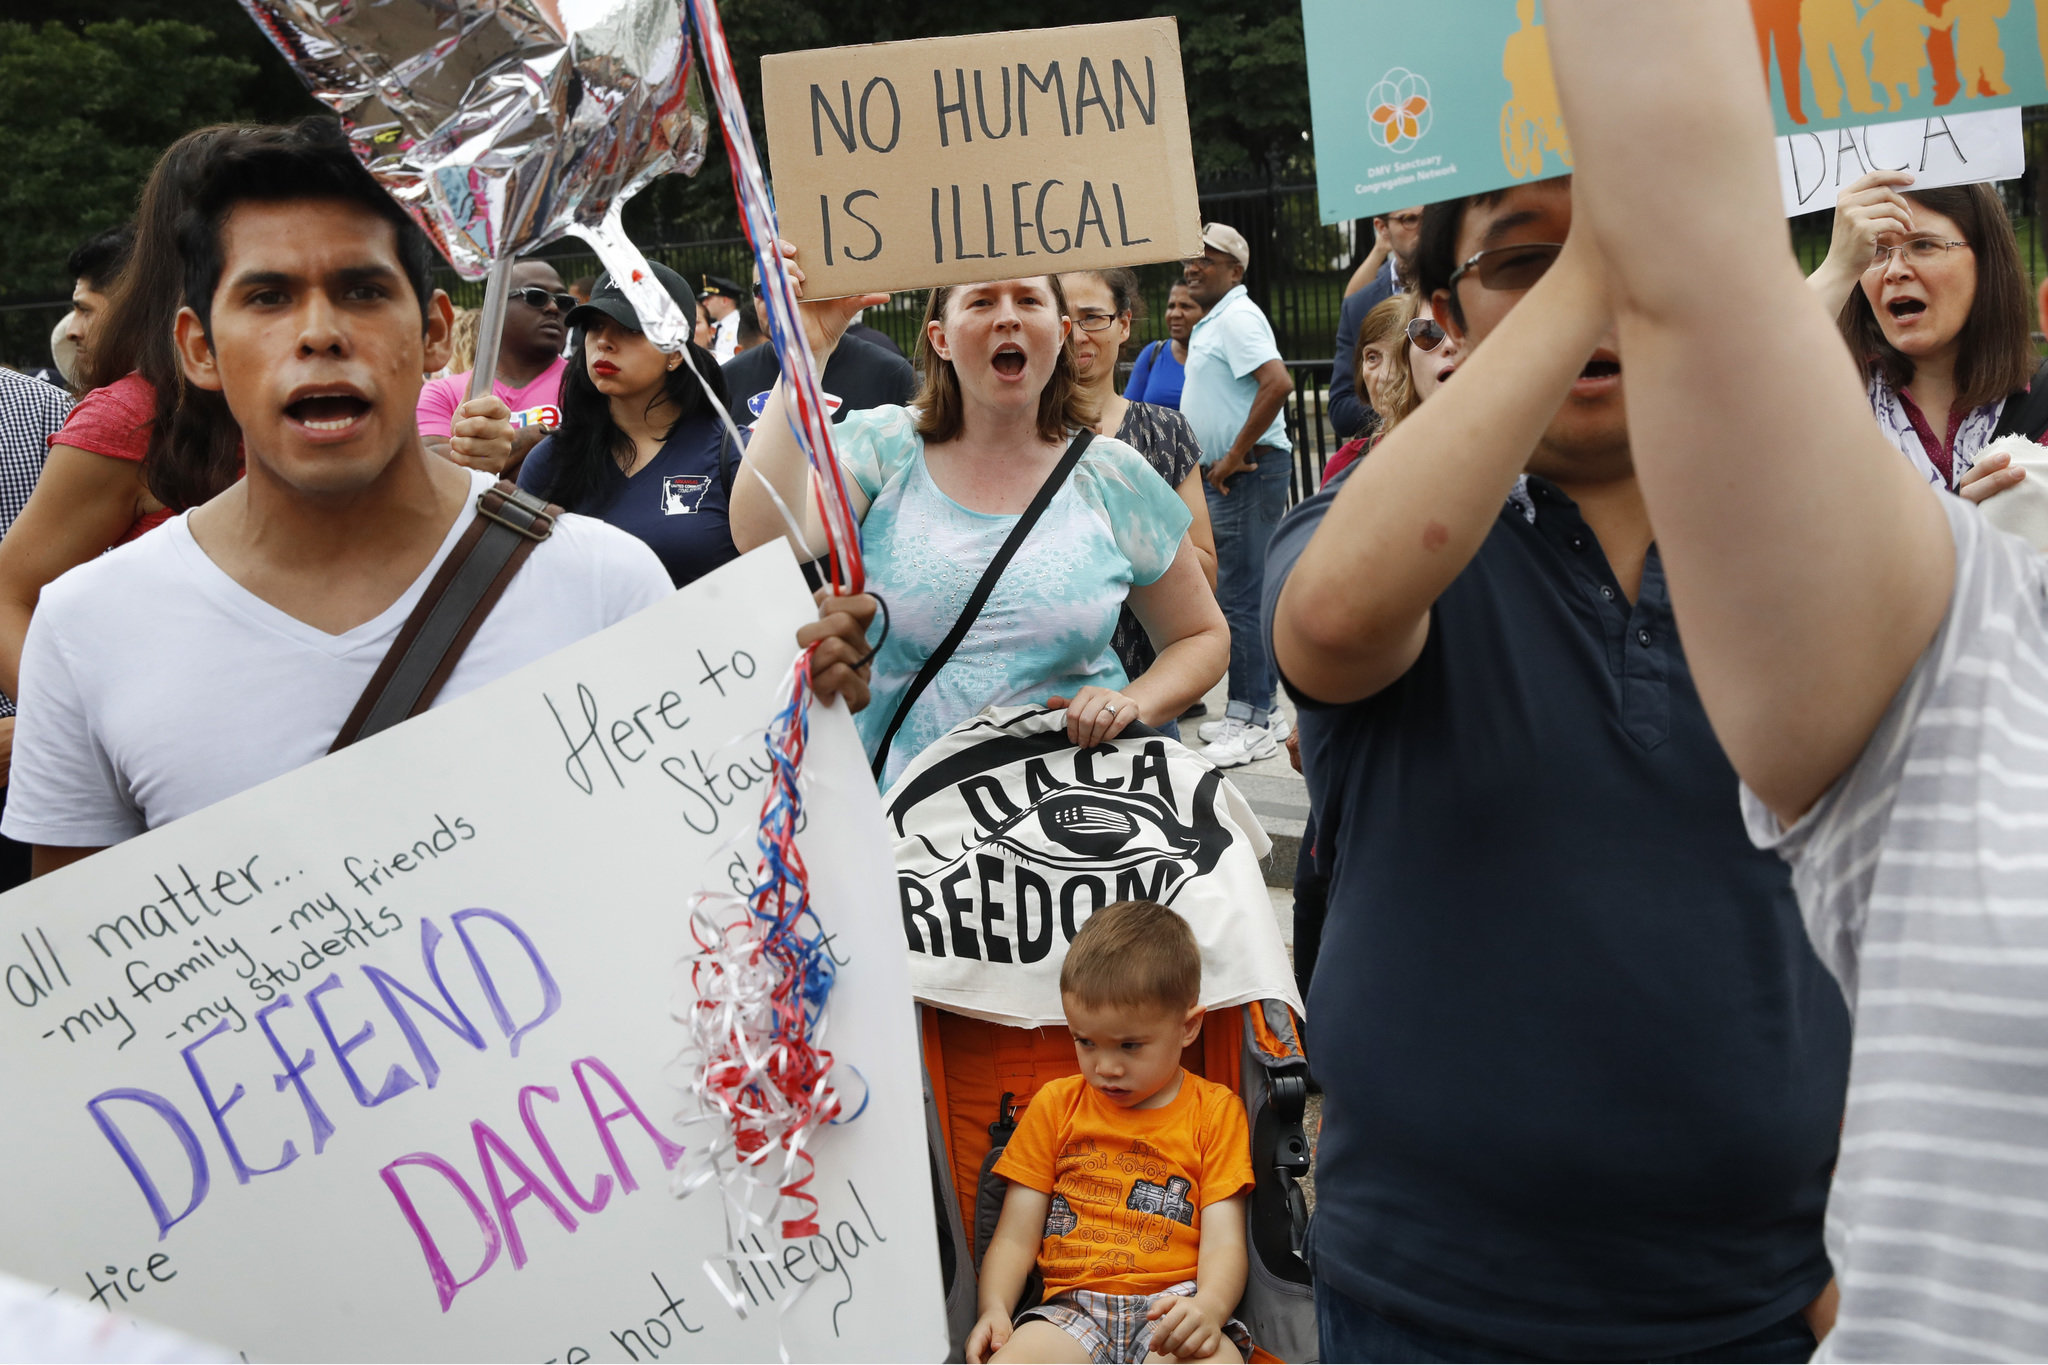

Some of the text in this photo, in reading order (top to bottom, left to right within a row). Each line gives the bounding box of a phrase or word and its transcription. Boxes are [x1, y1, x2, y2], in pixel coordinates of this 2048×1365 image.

[810, 56, 1156, 156] NO HUMAN
[1355, 164, 1457, 193] Congregation Network
[1368, 155, 1442, 177] DMV Sanctuary
[1788, 114, 1967, 205] DACA
[820, 179, 1152, 266] IS ILLEGAL
[543, 649, 756, 795] Here to
[957, 741, 1179, 834] DACA
[126, 935, 256, 1002] family
[344, 813, 476, 896] friends
[249, 906, 403, 1001] students
[898, 853, 1184, 964] REEDO
[6, 927, 71, 1007] all
[85, 907, 562, 1241] DEFEND
[378, 1056, 687, 1313] DACA
[84, 1252, 178, 1313] tice
[610, 1179, 887, 1361] not illegal
